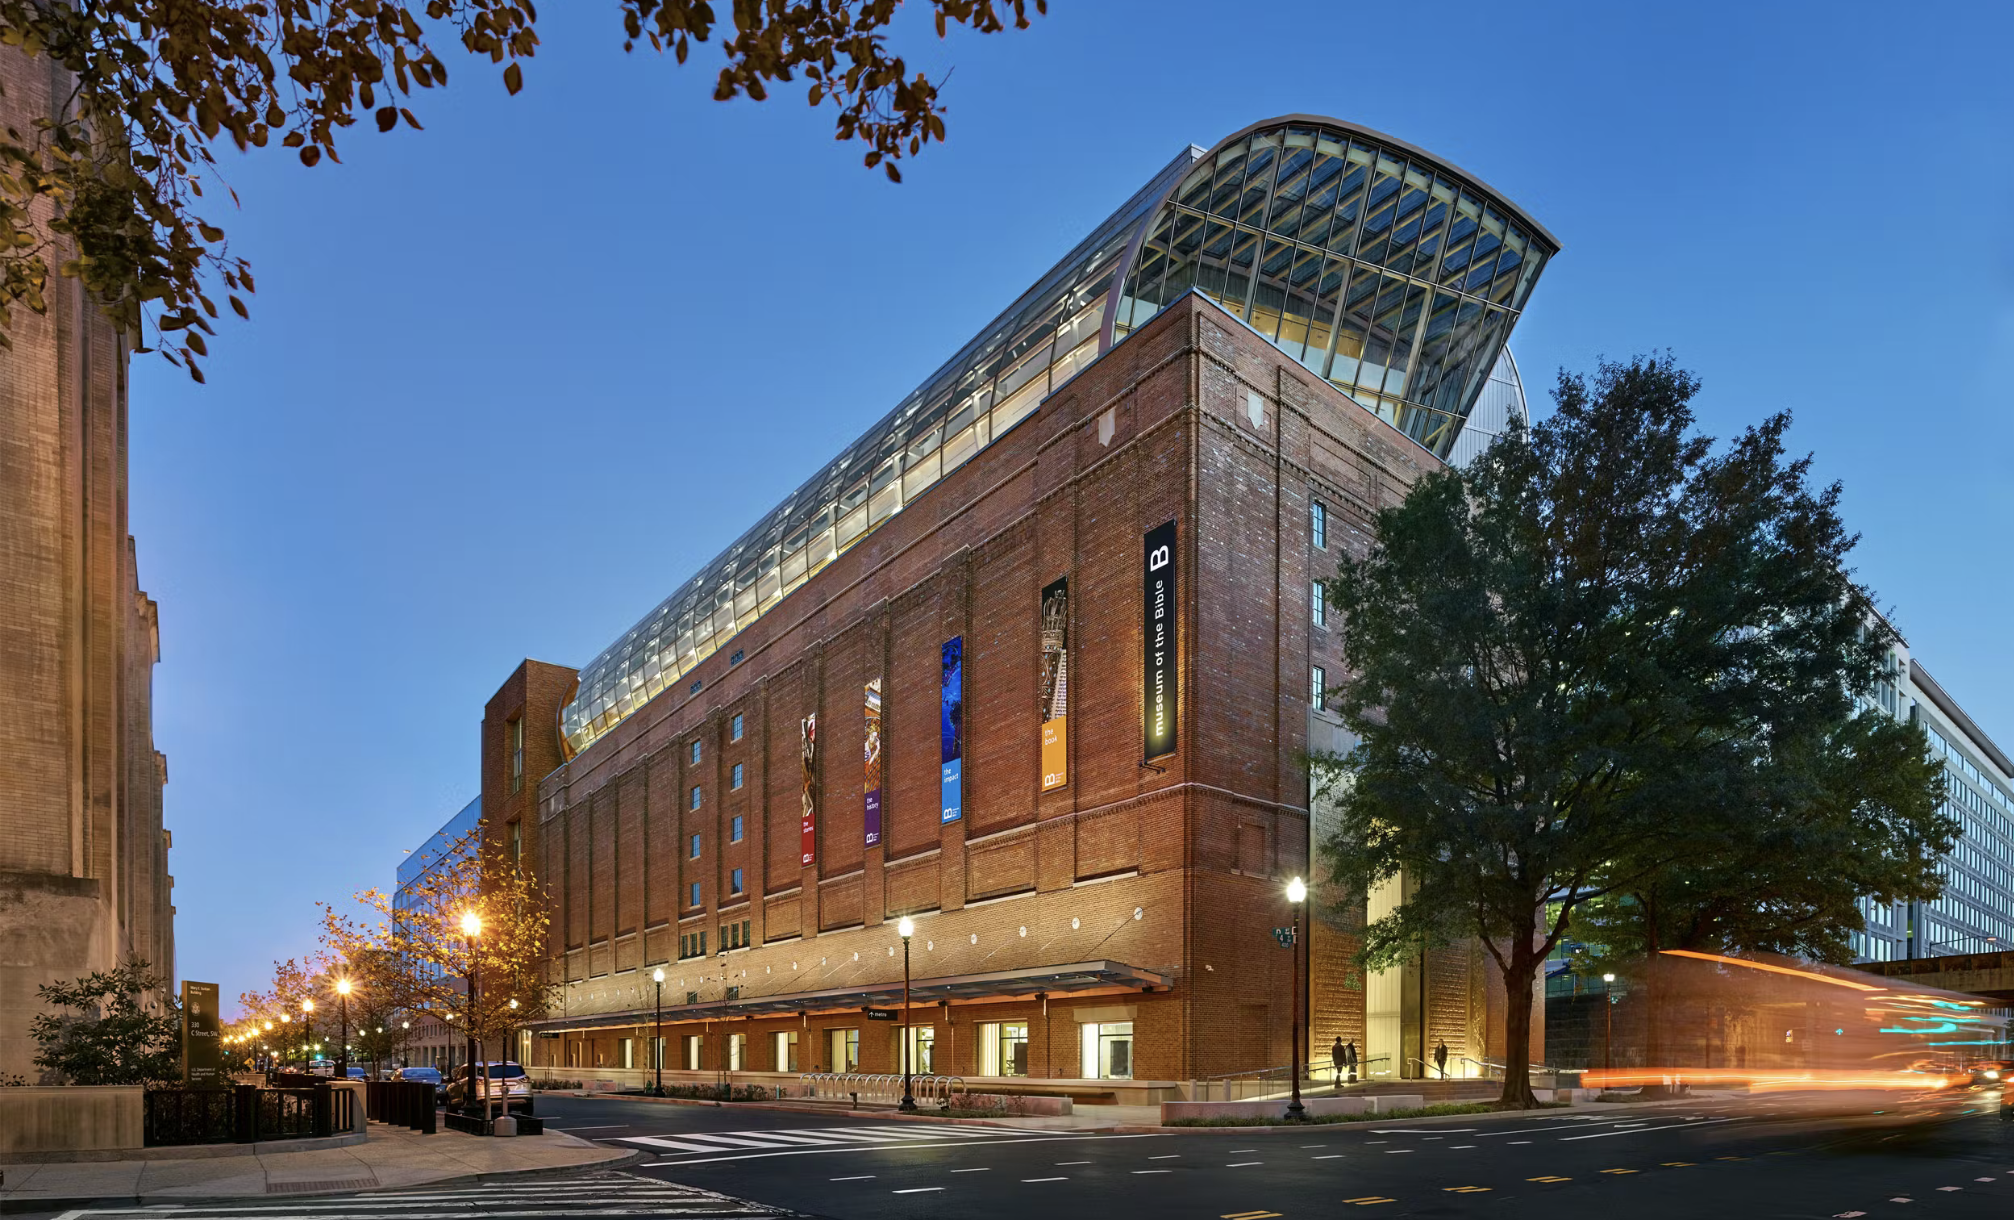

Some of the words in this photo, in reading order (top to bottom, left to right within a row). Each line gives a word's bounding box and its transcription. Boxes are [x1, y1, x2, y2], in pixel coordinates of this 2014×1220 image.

[1150, 545, 1169, 572] B
[1155, 580, 1164, 620] Bible
[1155, 623, 1164, 648] the
[1155, 651, 1164, 666] of
[1155, 670, 1164, 736] museum
[1044, 728, 1054, 736] the
[1044, 735, 1058, 746] book
[944, 773, 958, 784] impact
